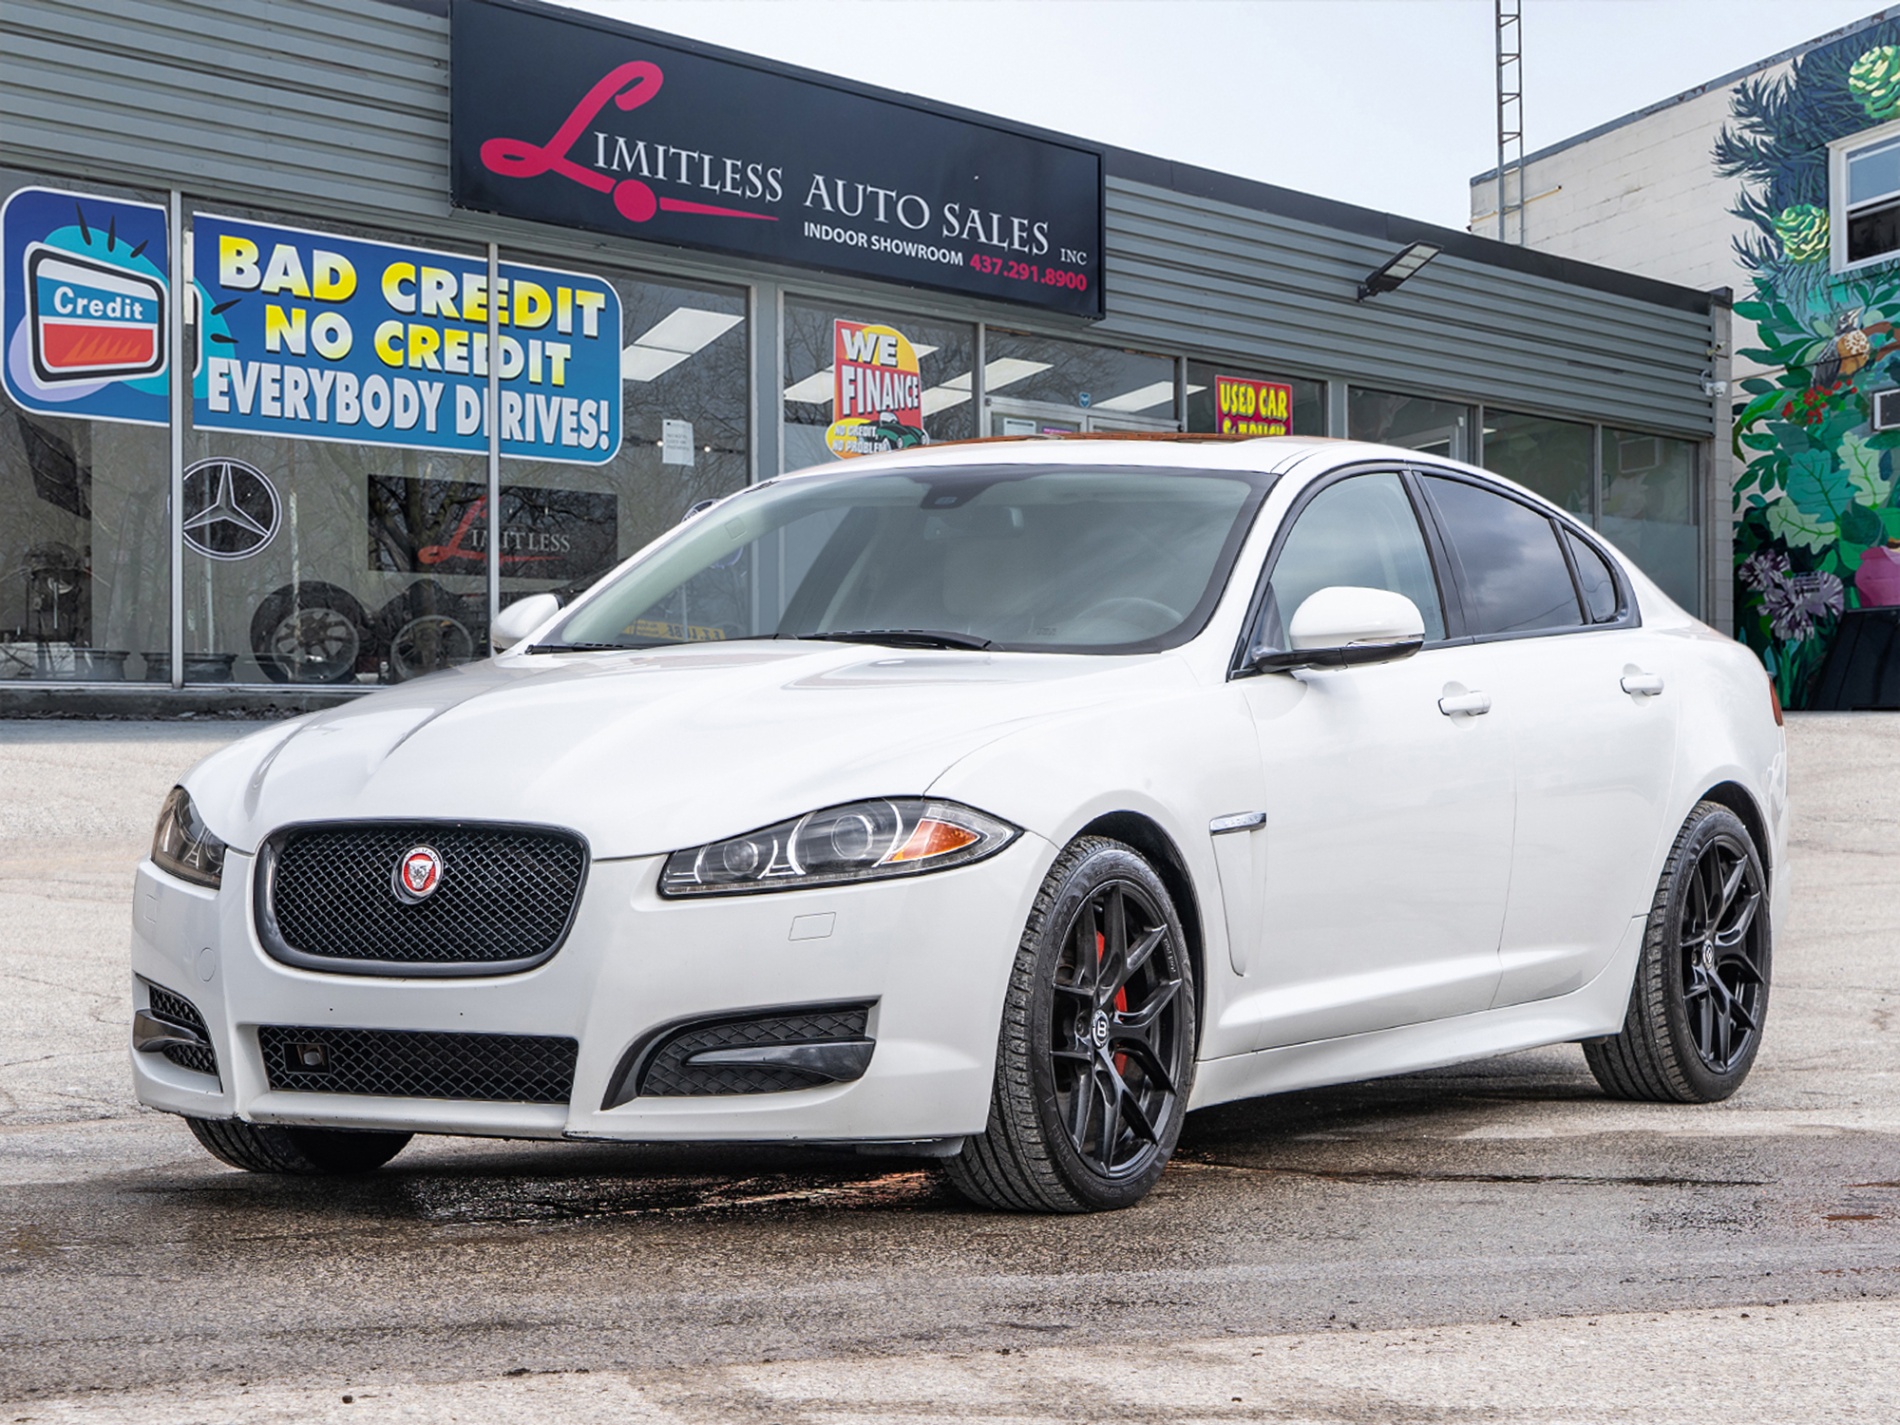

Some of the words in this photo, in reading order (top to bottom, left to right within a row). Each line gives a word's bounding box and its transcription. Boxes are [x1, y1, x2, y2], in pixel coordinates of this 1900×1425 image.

[480, 60, 783, 222] LIMITLESS
[803, 173, 930, 231] AUTO
[942, 202, 1049, 256] SALES
[1059, 247, 1087, 265] INC
[218, 234, 358, 303] BAD
[381, 261, 605, 338] CREDIT
[803, 221, 869, 248] INDOOR
[871, 235, 963, 266] SHOWROOM
[969, 253, 1088, 292] 437.291.8900
[53, 285, 144, 320] Credit
[265, 304, 353, 361] NO
[373, 319, 572, 387] CREDIT
[840, 328, 898, 367] WE
[208, 356, 444, 433] EVERYBODY
[455, 384, 610, 451] DRIVES!
[841, 364, 919, 417] FINANCE
[1219, 381, 1256, 417] USED
[1258, 385, 1289, 422] CAR
[832, 439, 844, 452] NO
[835, 425, 846, 436] NO
[418, 494, 571, 565] LIITLESS
